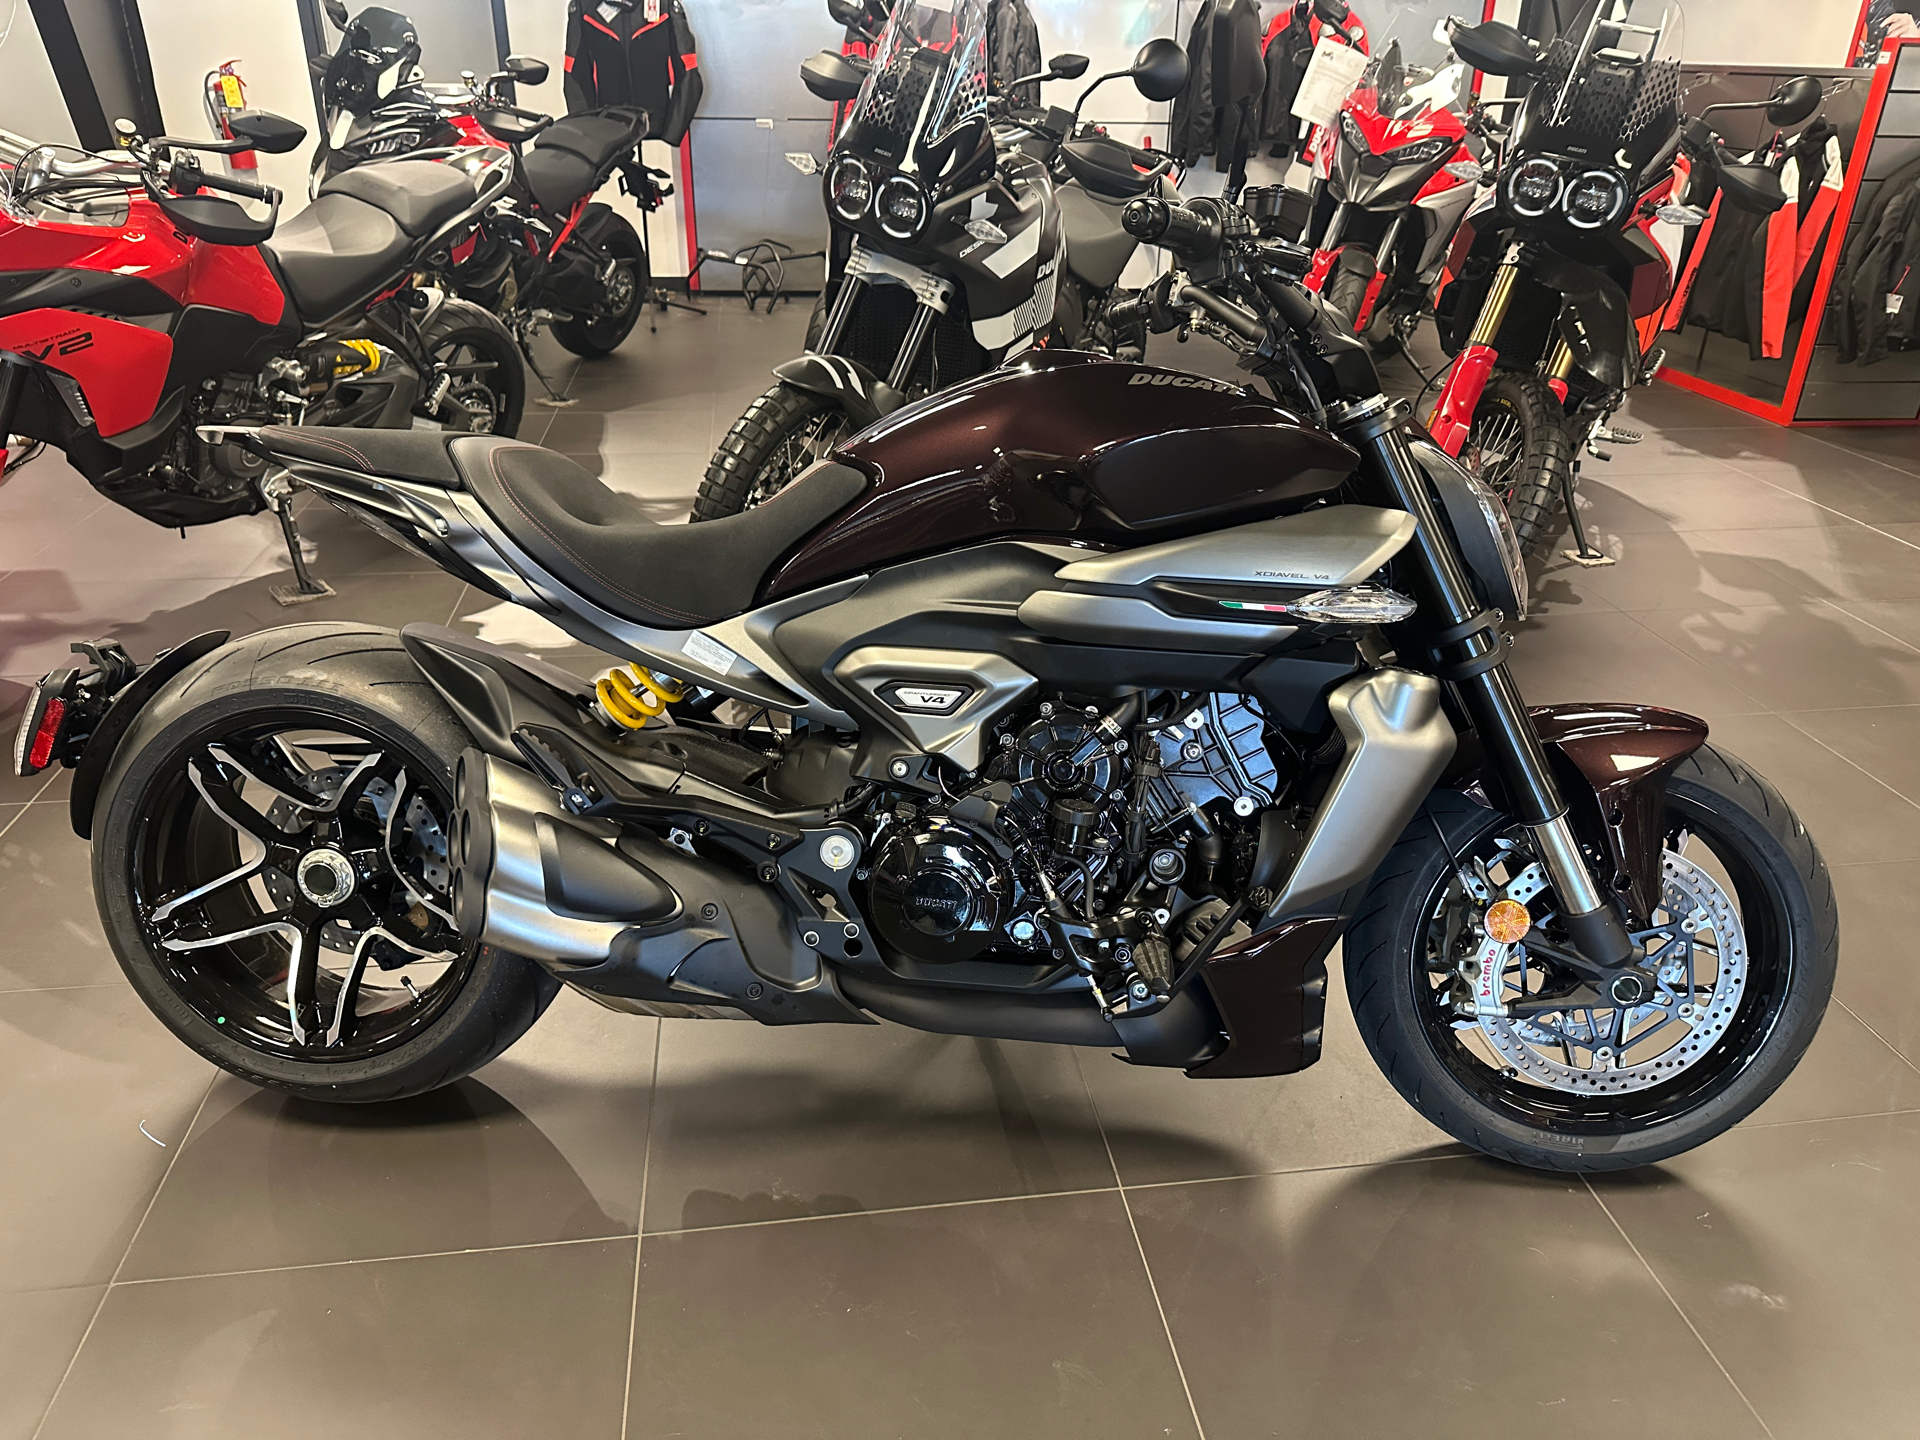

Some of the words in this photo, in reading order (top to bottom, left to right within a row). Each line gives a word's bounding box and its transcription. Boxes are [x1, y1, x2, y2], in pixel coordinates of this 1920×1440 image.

[21, 332, 94, 361] V2
[1255, 571, 1309, 579] XDIAVEL
[1480, 949, 1496, 996] brembo
